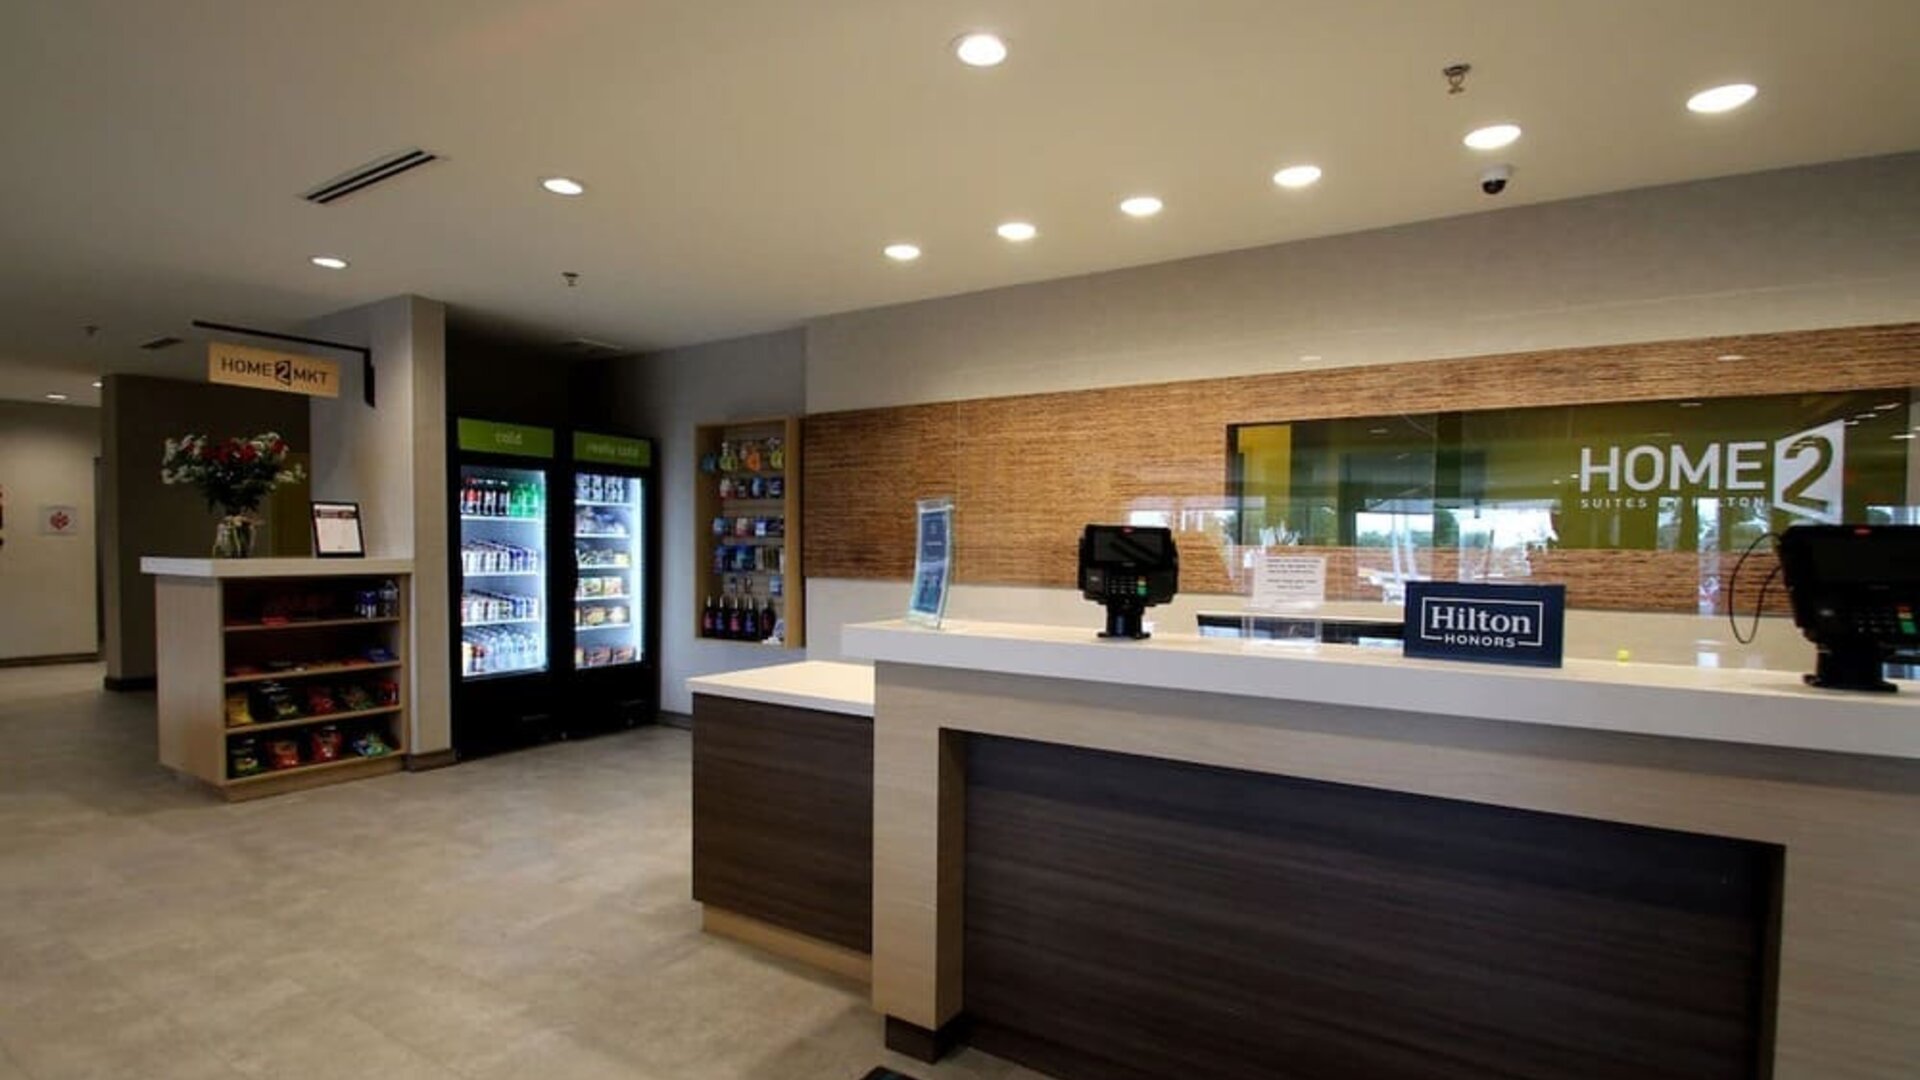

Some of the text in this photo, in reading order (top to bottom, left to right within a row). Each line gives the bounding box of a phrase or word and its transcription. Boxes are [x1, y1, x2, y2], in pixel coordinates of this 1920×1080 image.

[1580, 497, 1648, 509] SUITES
[1692, 497, 1766, 509] HTON
[1430, 606, 1532, 634] Hilton
[1445, 634, 1517, 648] HONORS
